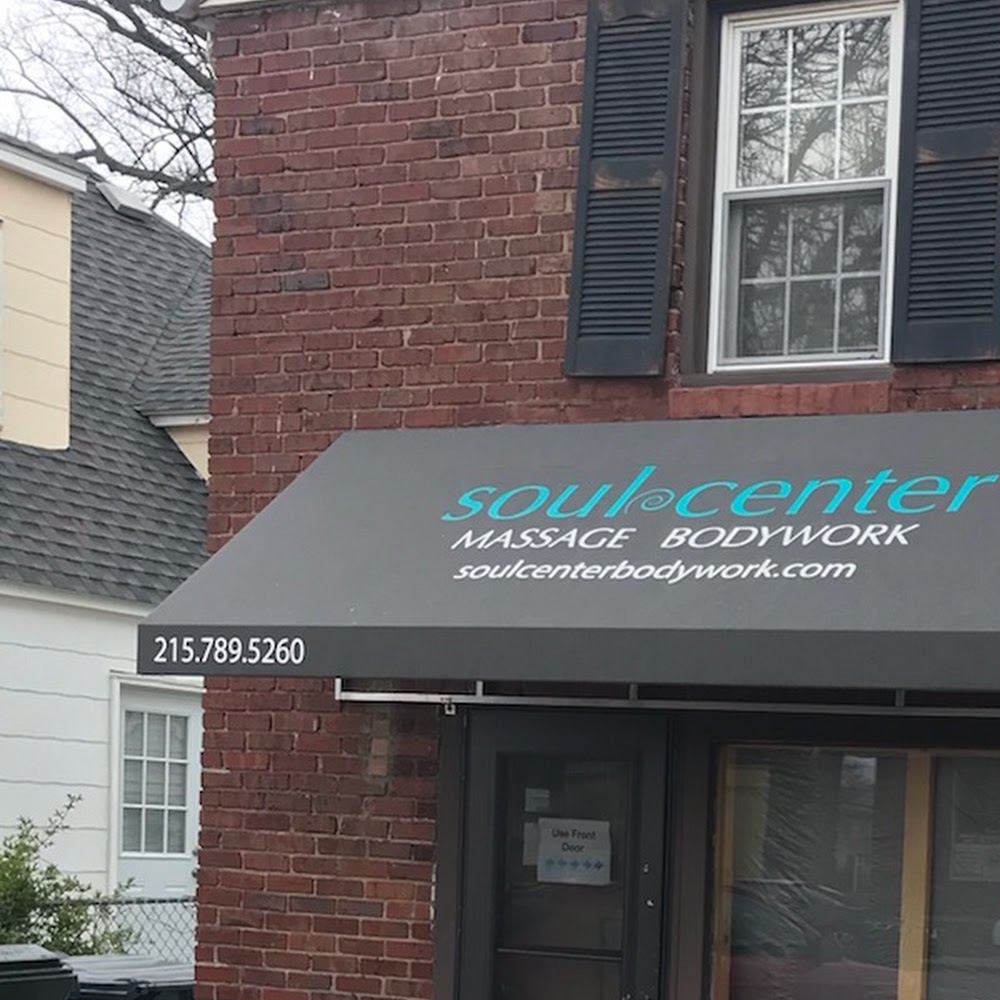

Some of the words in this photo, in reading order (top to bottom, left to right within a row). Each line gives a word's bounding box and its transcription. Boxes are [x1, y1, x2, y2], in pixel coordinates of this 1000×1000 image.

[674, 467, 1000, 518] center
[450, 526, 638, 550] MASSAGE
[659, 523, 921, 549] BODYWORK
[452, 557, 858, 585] soulcenterbodywork.com
[153, 636, 306, 665] 215.789.5260
[552, 828, 570, 838] Use
[571, 829, 597, 840] Front
[561, 842, 585, 853] Door
